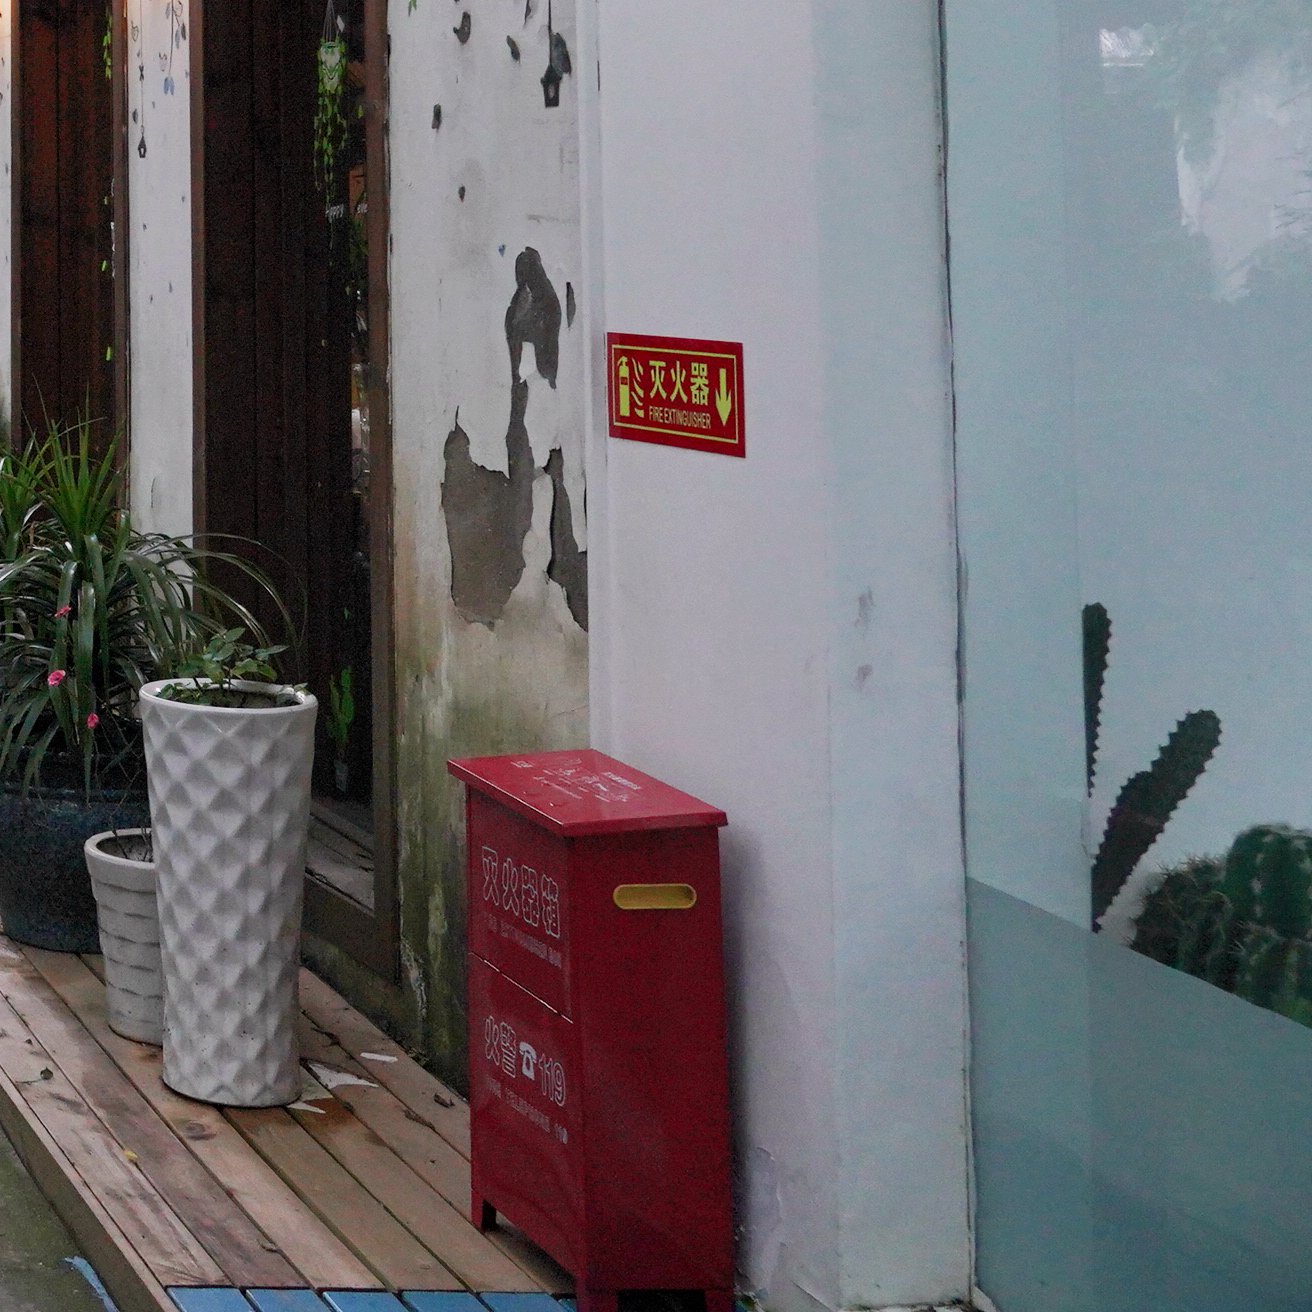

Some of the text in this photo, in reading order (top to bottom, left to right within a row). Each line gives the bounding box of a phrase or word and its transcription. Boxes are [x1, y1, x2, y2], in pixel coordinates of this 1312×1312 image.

[649, 360, 709, 406] 灭火器
[649, 405, 711, 429] FIRE EXTINGUISHER
[482, 845, 560, 939] 灭火器箱
[485, 1015, 566, 1107] 火警 119
